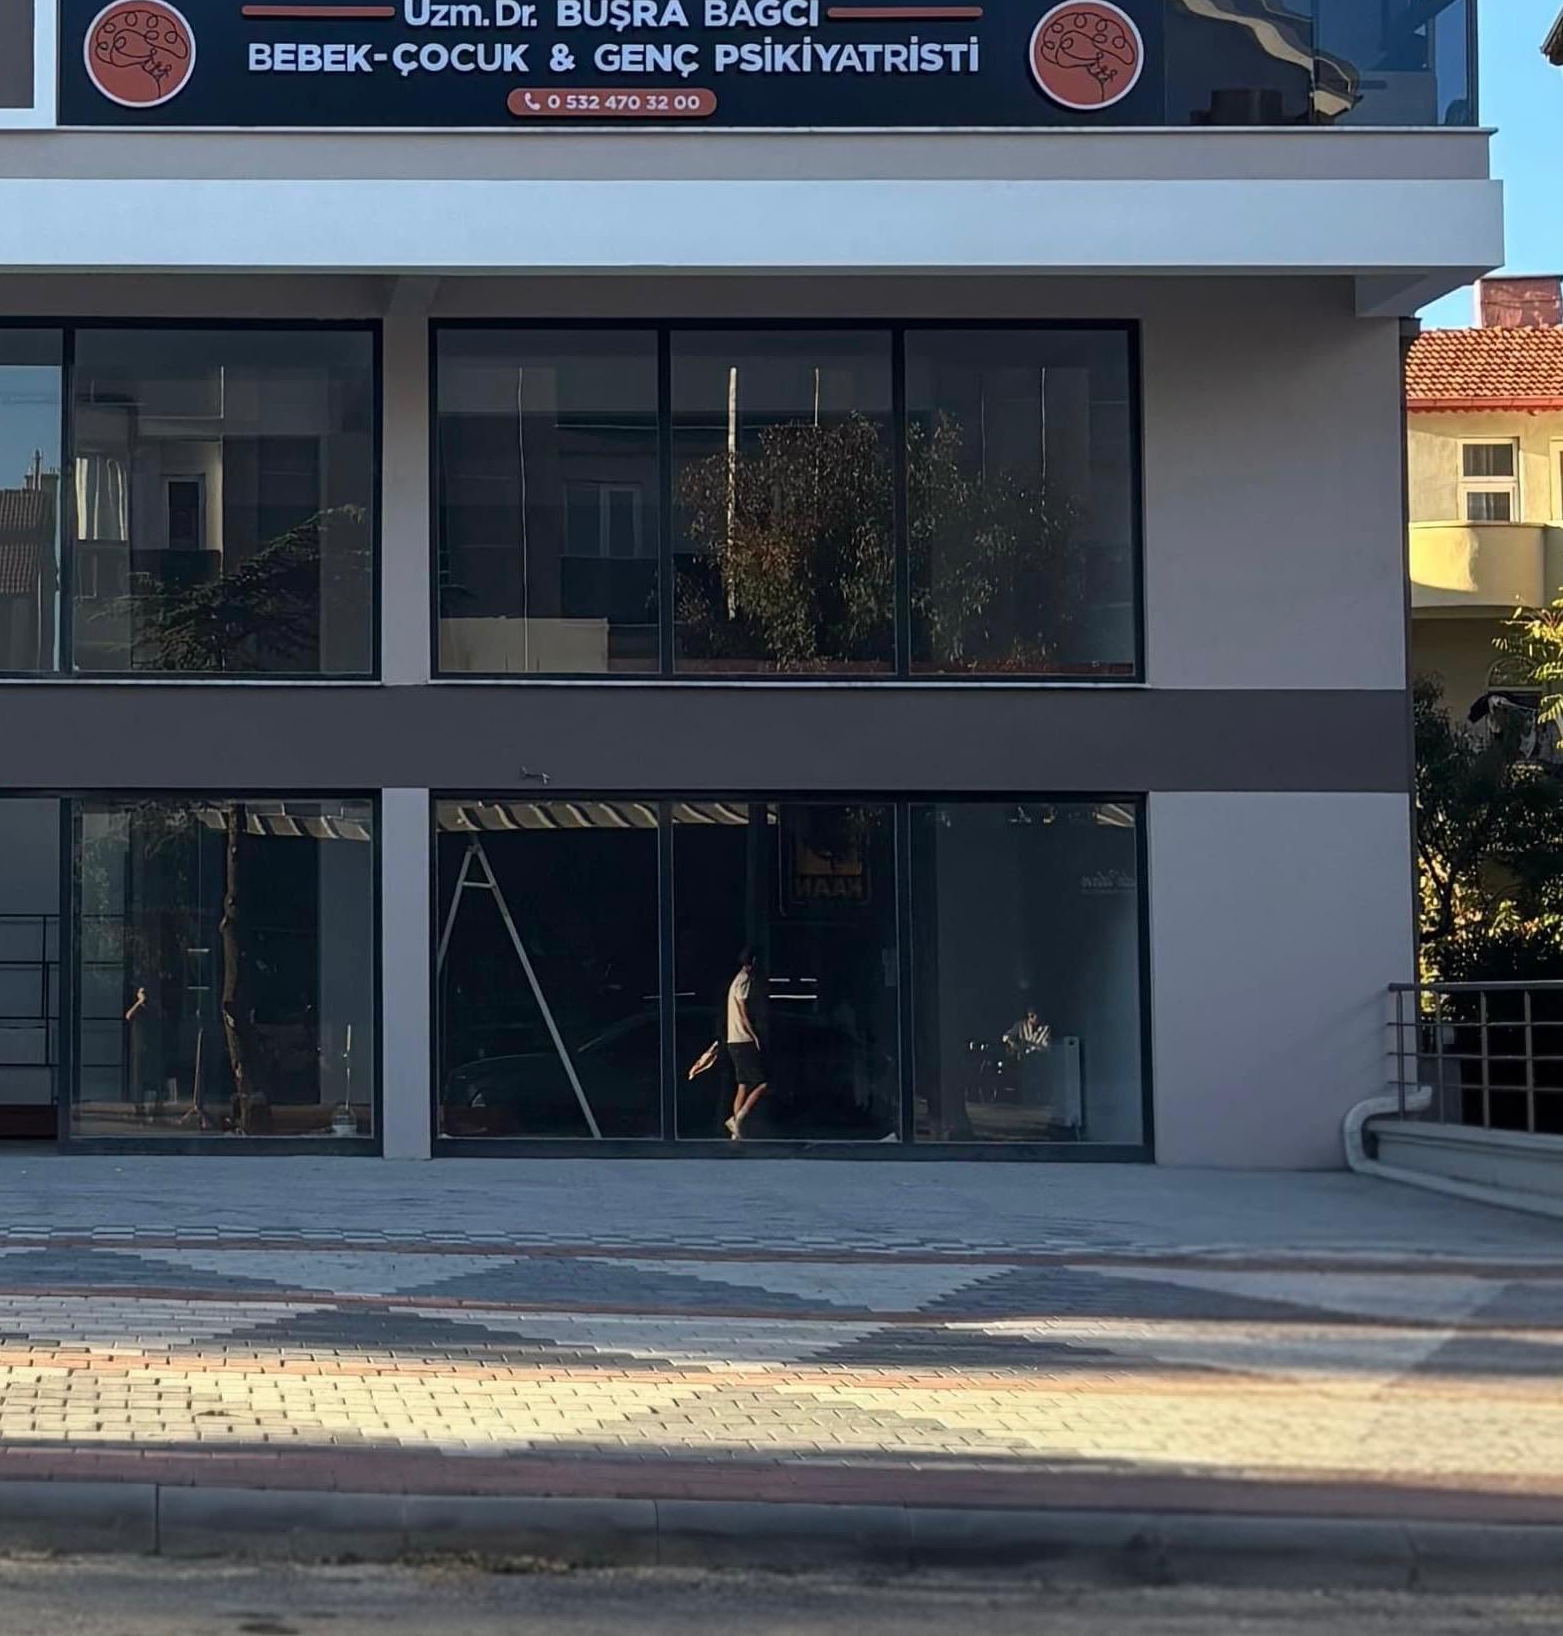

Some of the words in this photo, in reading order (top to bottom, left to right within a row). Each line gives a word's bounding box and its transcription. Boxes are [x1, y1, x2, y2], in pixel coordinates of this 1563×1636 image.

[249, 42, 529, 77] BEBEK-ÇOCUK
[549, 43, 576, 72] &
[594, 43, 699, 78] GENÇ
[715, 35, 979, 72] PSİKİYATRİSTİ
[547, 94, 561, 109] 0
[566, 94, 600, 109] 532
[604, 94, 641, 110] 470
[646, 94, 669, 110] 32
[674, 94, 700, 110] 00
